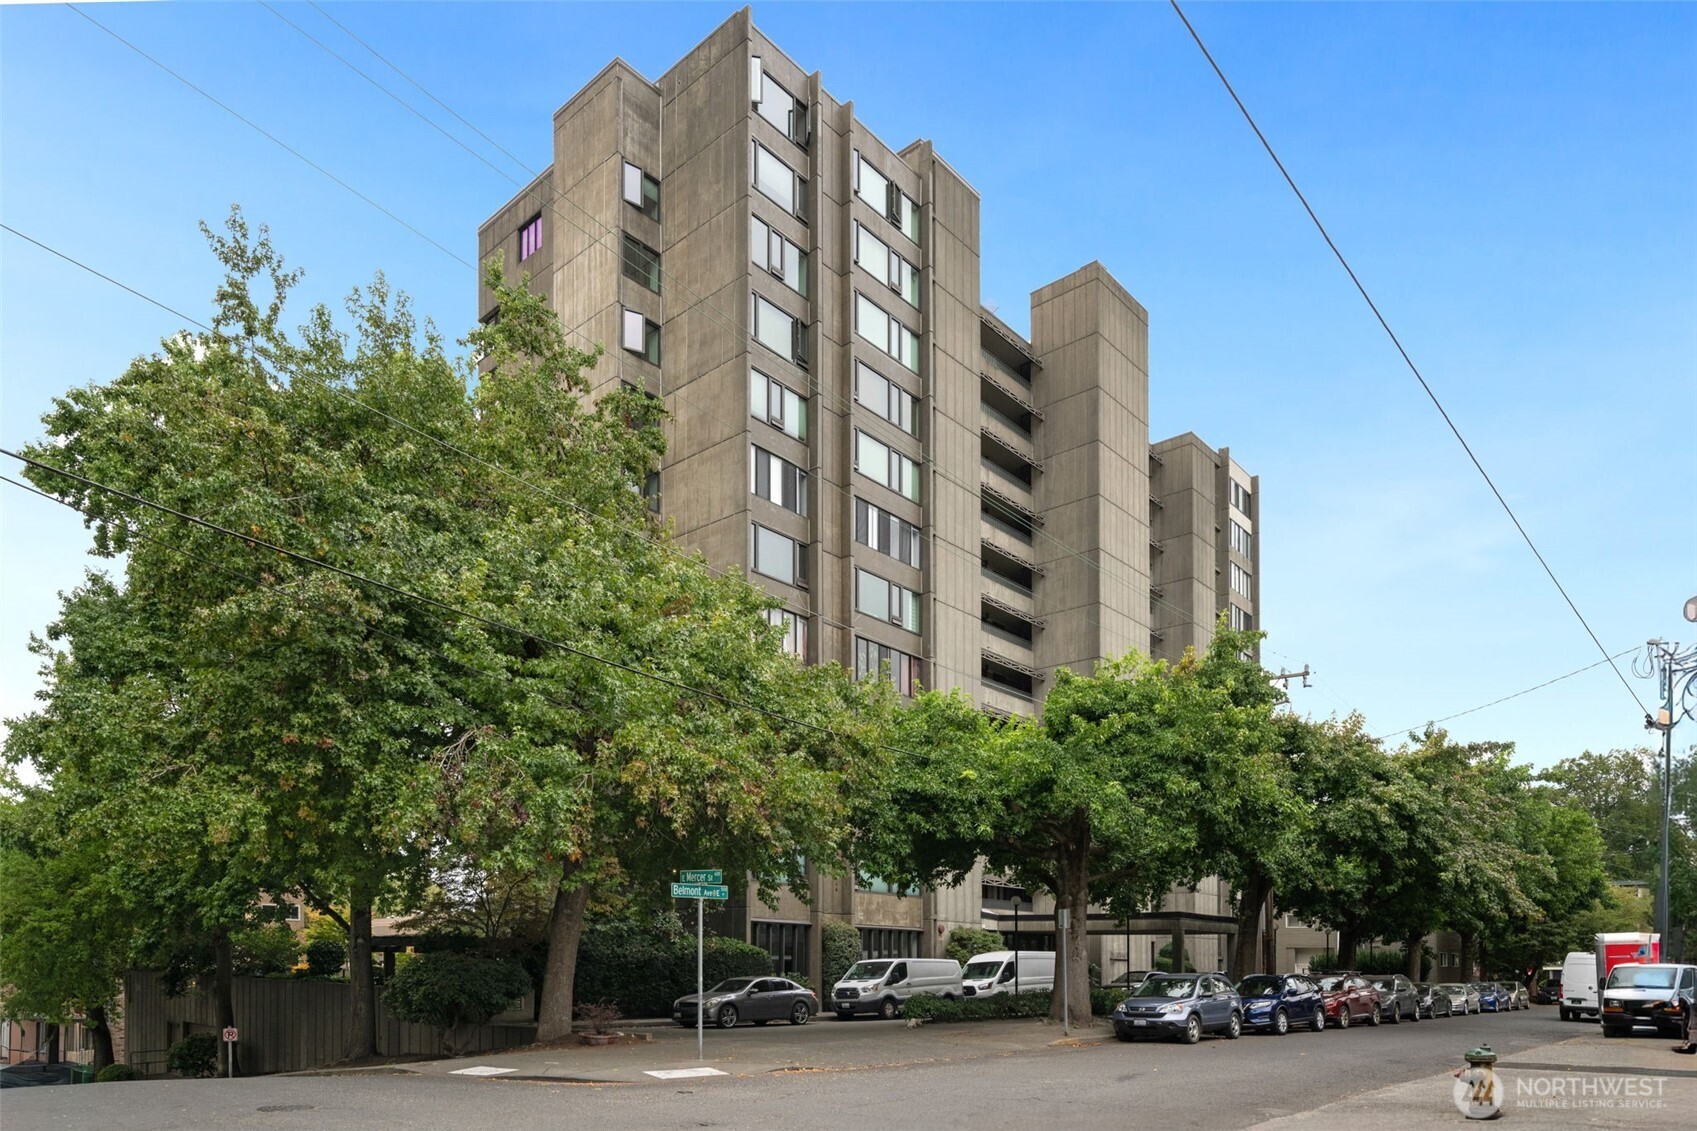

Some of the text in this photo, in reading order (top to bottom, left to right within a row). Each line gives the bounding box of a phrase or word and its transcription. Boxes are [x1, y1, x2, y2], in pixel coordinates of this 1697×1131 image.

[686, 872, 707, 882] Mercer
[673, 884, 702, 896] Belmont
[703, 889, 713, 897] Ave
